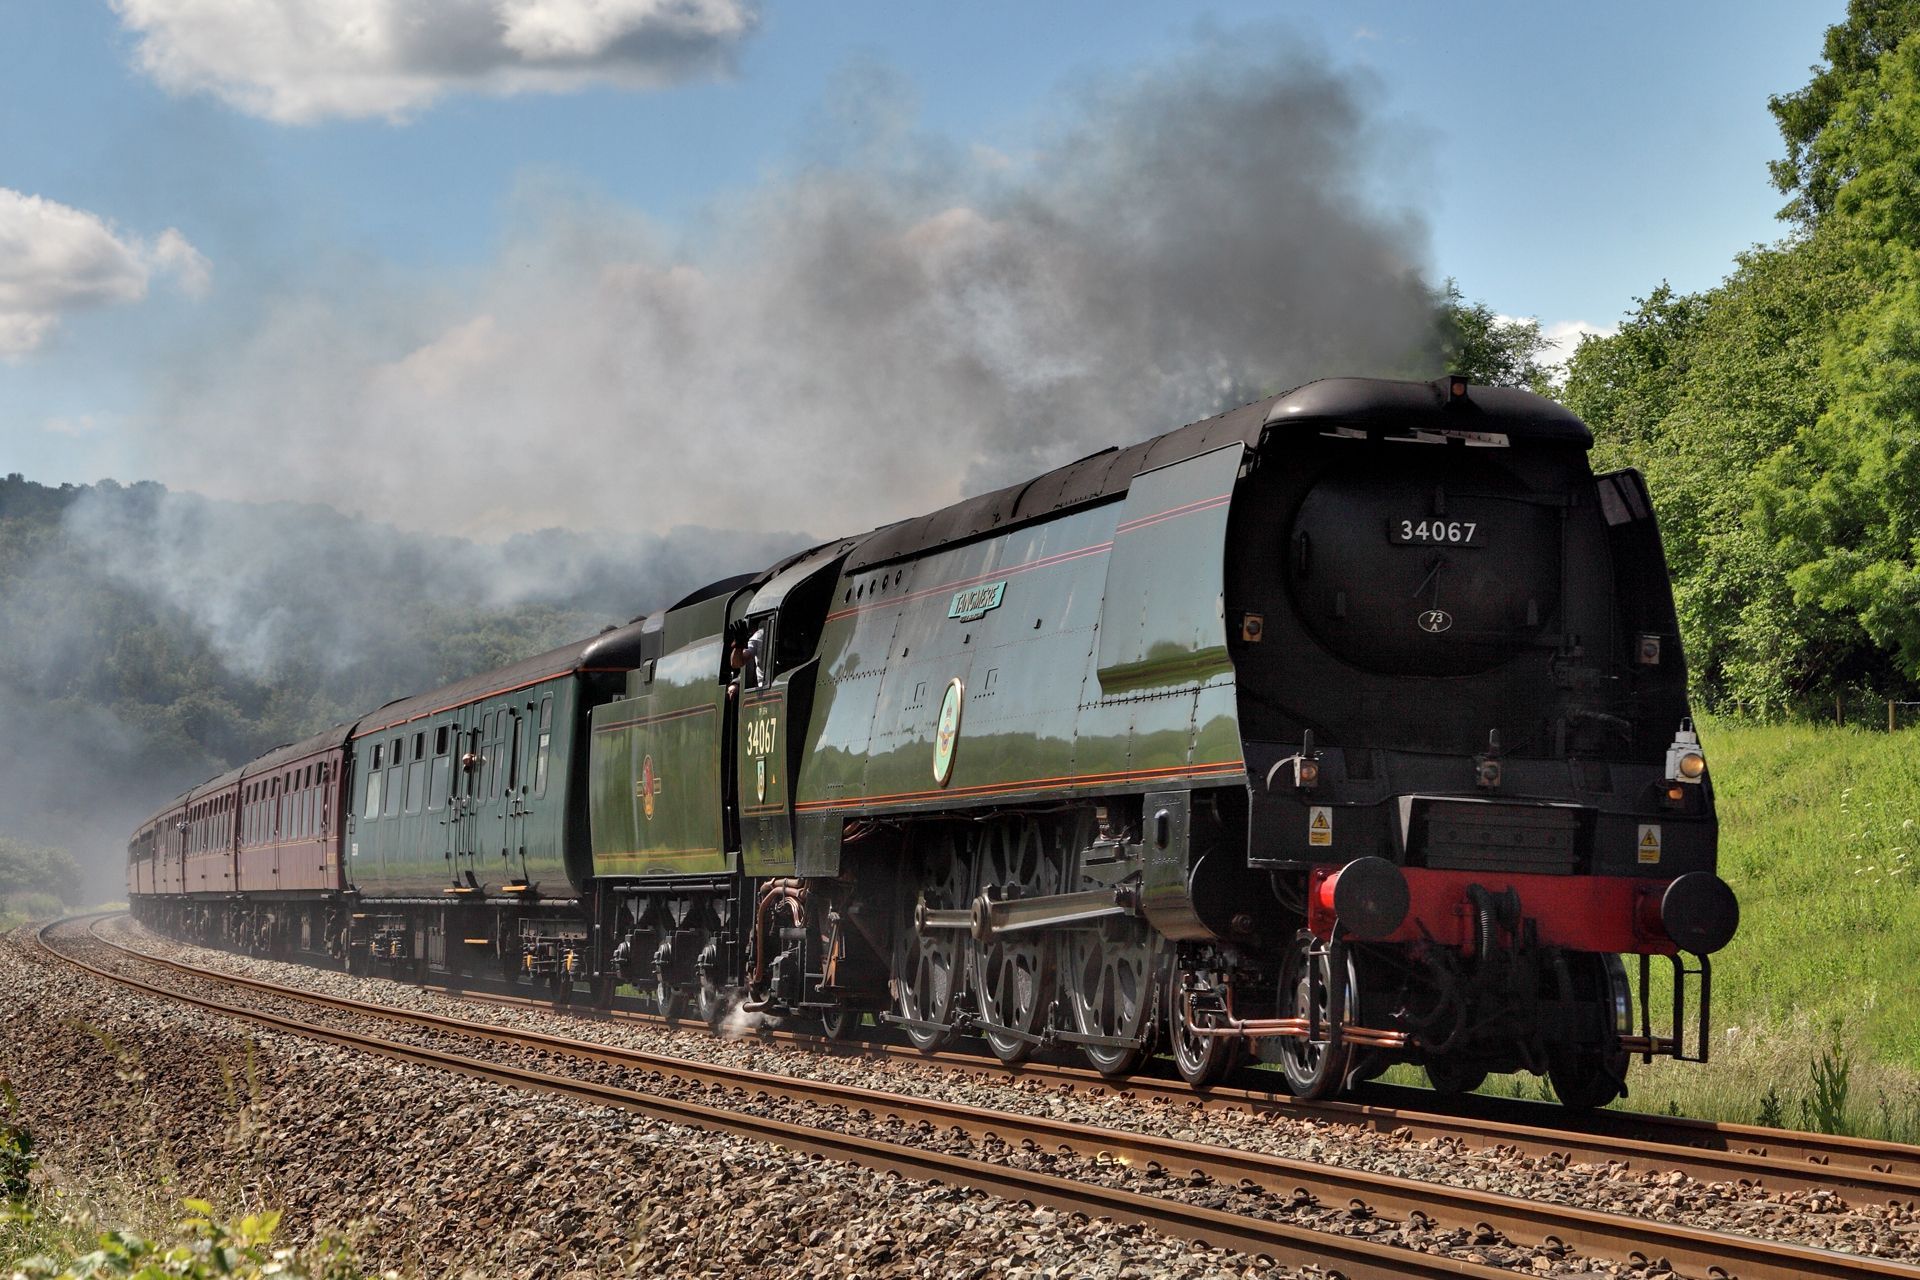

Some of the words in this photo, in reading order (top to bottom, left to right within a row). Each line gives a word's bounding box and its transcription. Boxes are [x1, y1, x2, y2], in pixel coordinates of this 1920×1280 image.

[1401, 520, 1477, 542] 34067
[1429, 612, 1443, 623] 73
[747, 717, 777, 756] 34067
